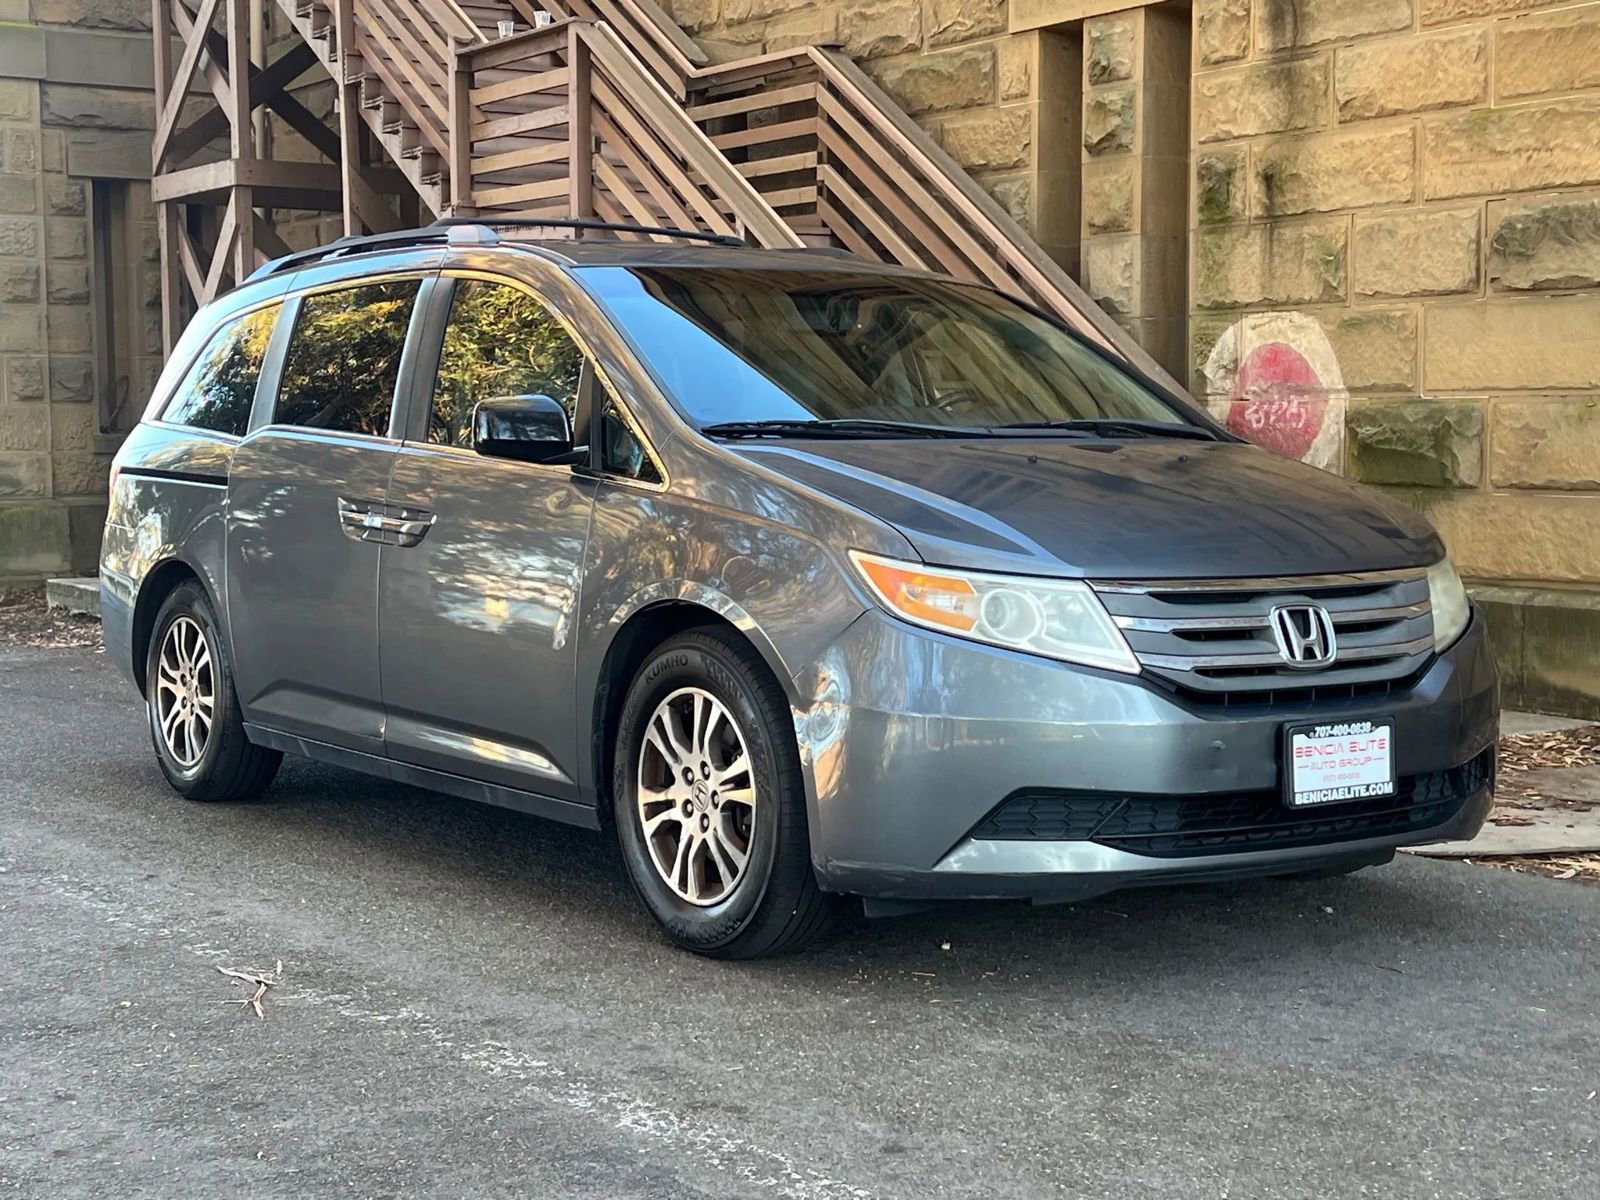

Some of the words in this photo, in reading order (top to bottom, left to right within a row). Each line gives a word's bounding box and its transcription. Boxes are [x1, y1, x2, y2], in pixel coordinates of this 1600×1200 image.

[644, 654, 689, 685] KUMHO
[1349, 738, 1386, 753] ELITE
[1310, 760, 1336, 770] AUTO
[1339, 756, 1372, 767] GROUP
[1294, 781, 1393, 806] BENICIAELITE.COM
